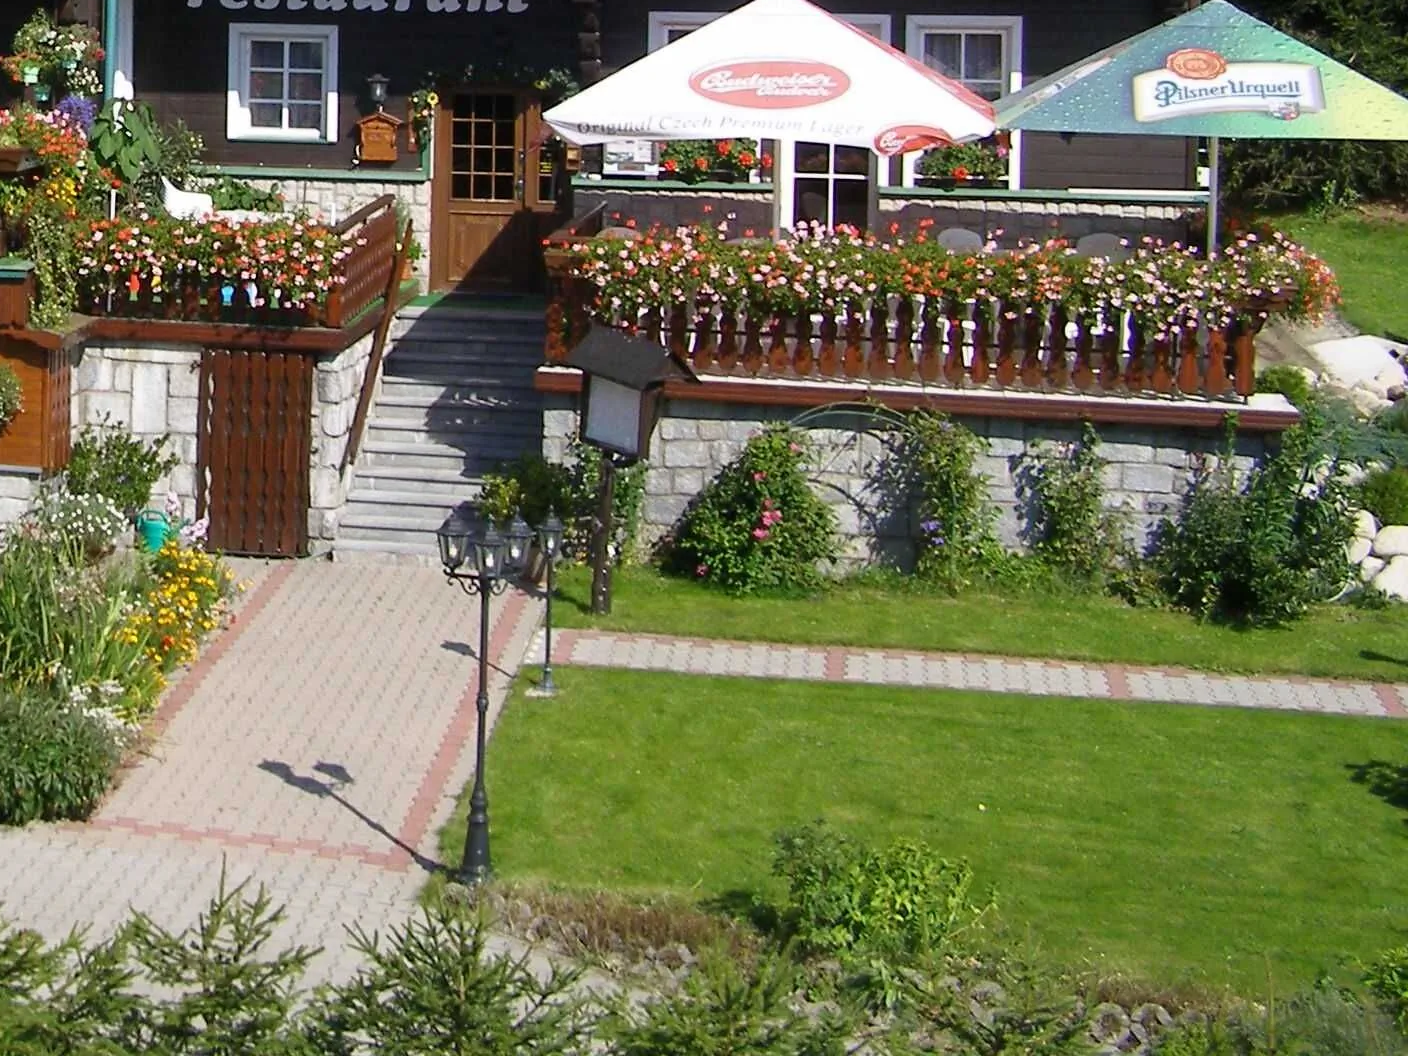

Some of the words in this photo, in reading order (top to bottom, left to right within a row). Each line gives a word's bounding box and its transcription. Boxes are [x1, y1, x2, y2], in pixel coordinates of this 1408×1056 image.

[1154, 80, 1230, 108] Pilsner
[1227, 79, 1301, 99] Urquell
[577, 116, 653, 135] Original
[658, 115, 713, 131] Czech
[719, 115, 803, 132] Premium
[809, 119, 866, 135] Lager
